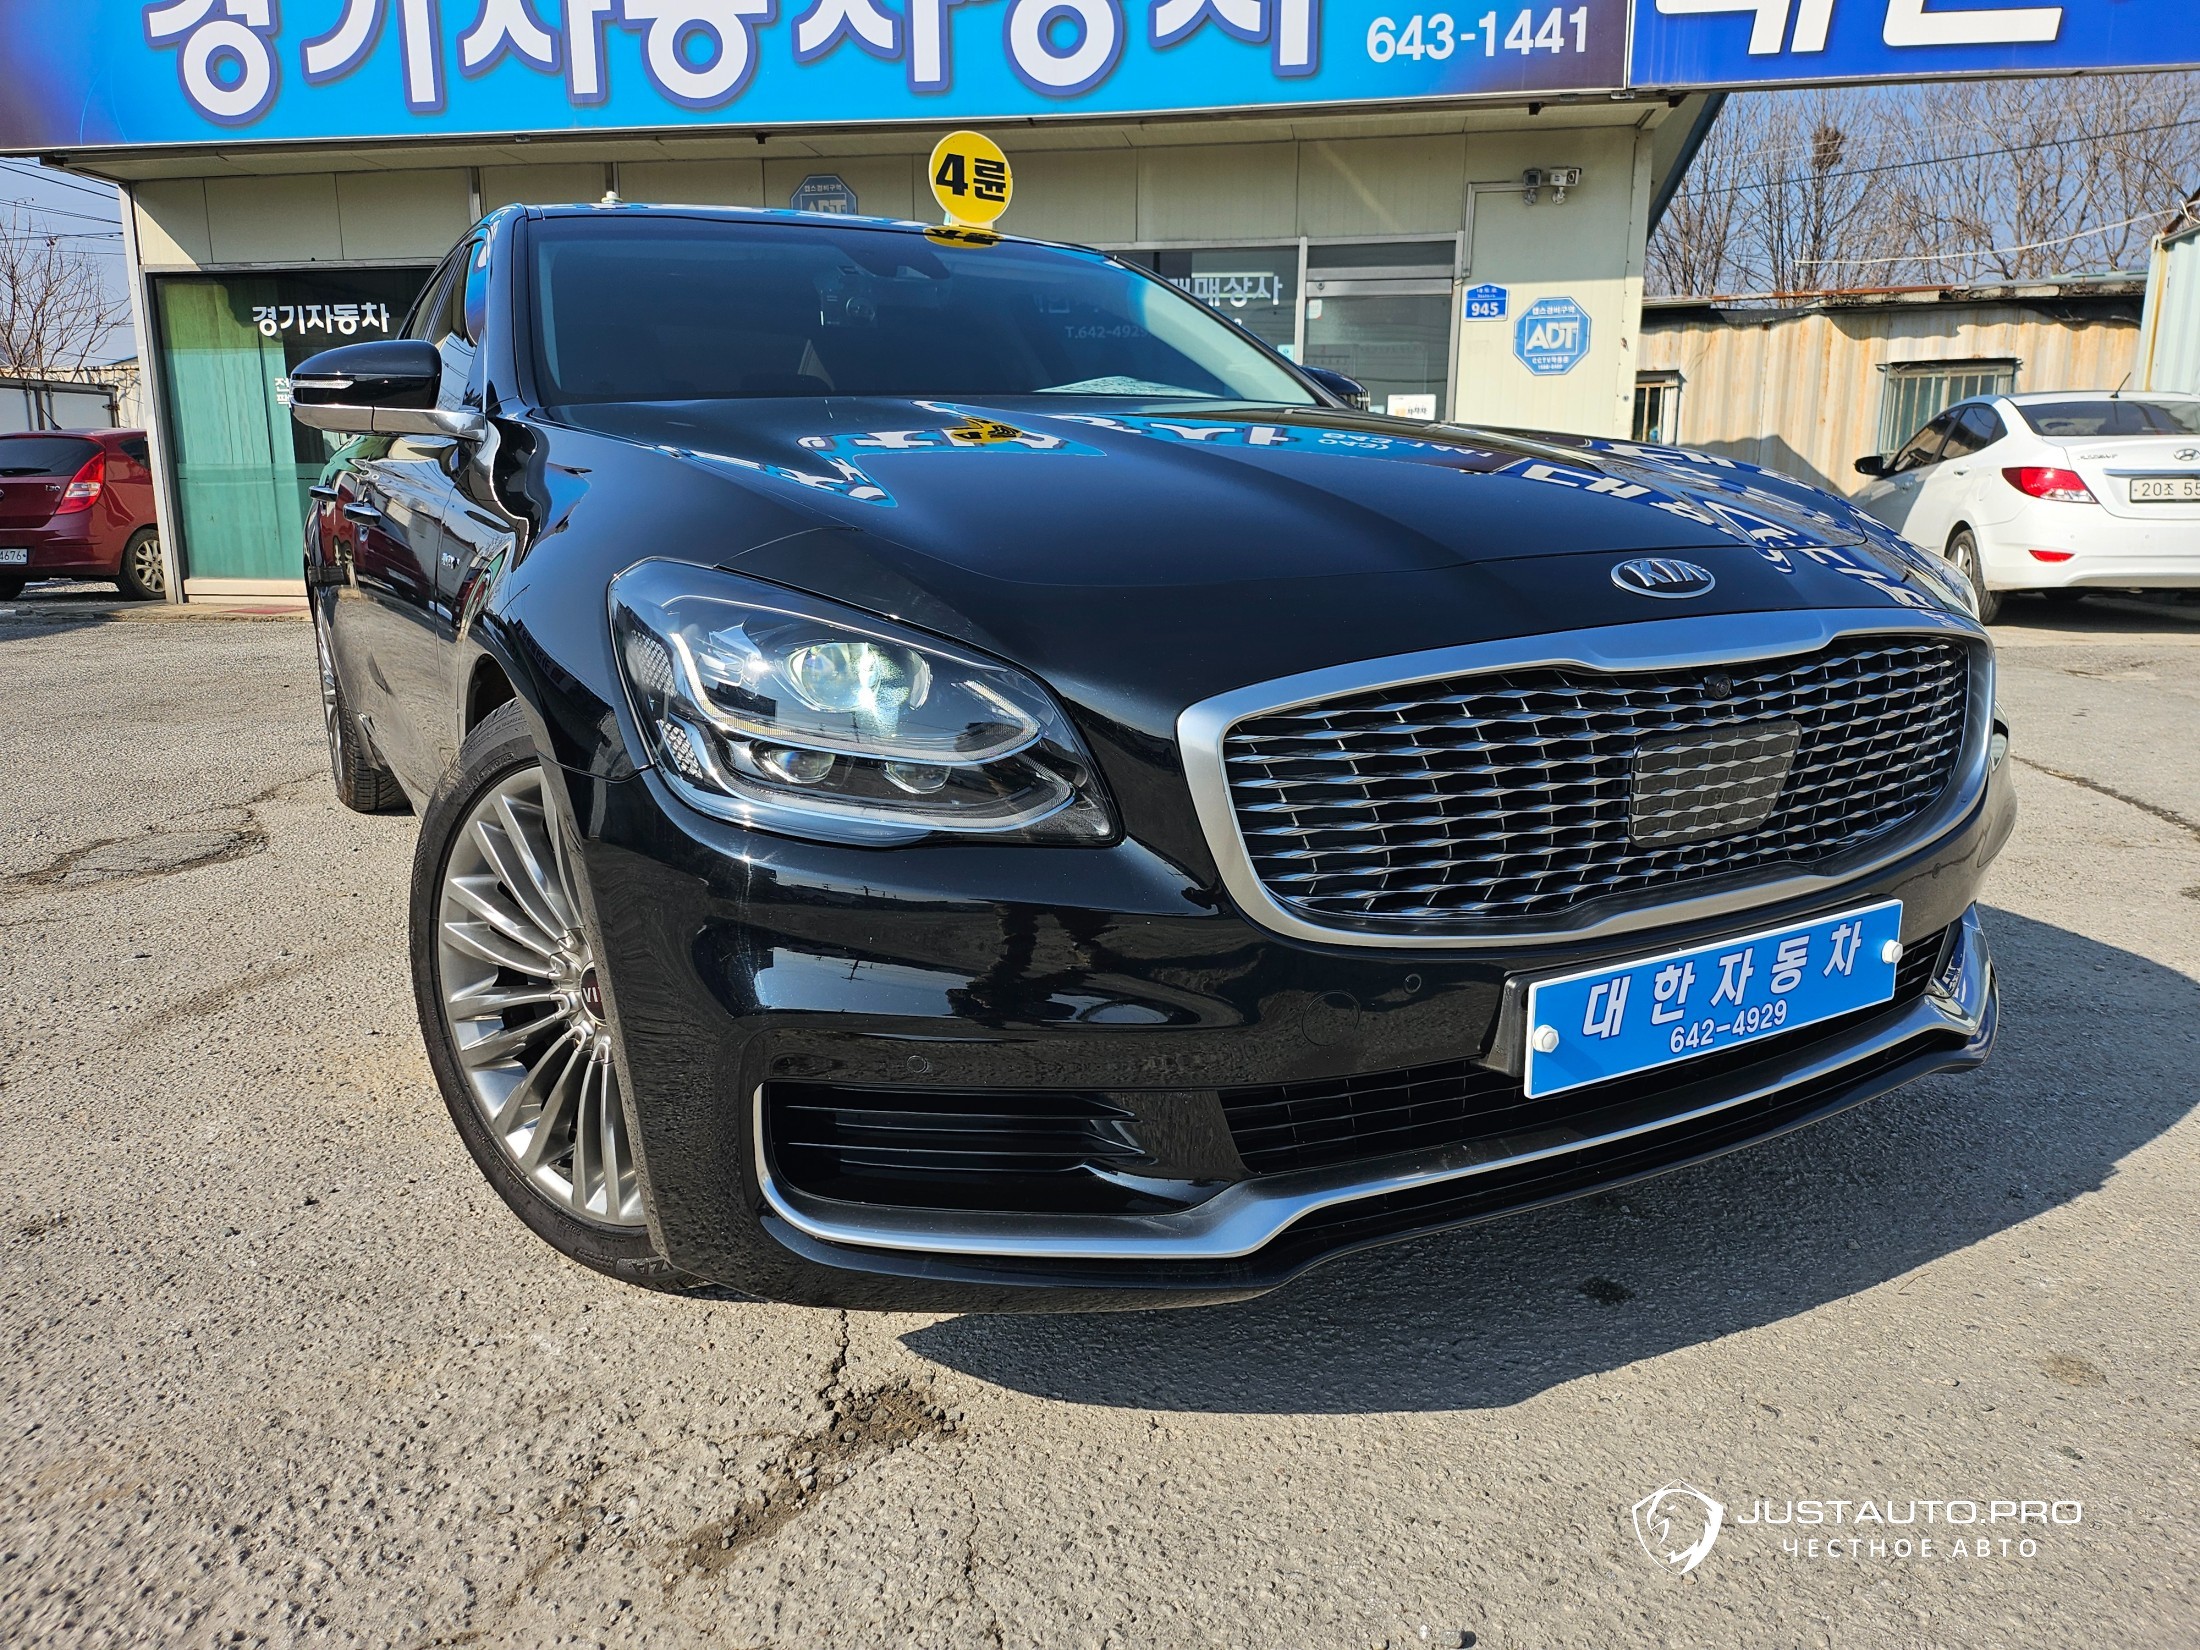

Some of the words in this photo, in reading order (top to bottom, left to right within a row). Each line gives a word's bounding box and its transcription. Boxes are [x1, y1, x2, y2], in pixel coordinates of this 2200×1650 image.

[1366, 6, 1588, 63] 643-1441
[936, 153, 1006, 202] 4륜
[252, 302, 390, 337] 경기자동차
[1471, 302, 1499, 317] 945
[1526, 321, 1577, 350] ADT
[2141, 482, 2174, 496] 20조
[1623, 560, 1709, 587] KIA
[1669, 999, 1788, 1053] 642-4929
